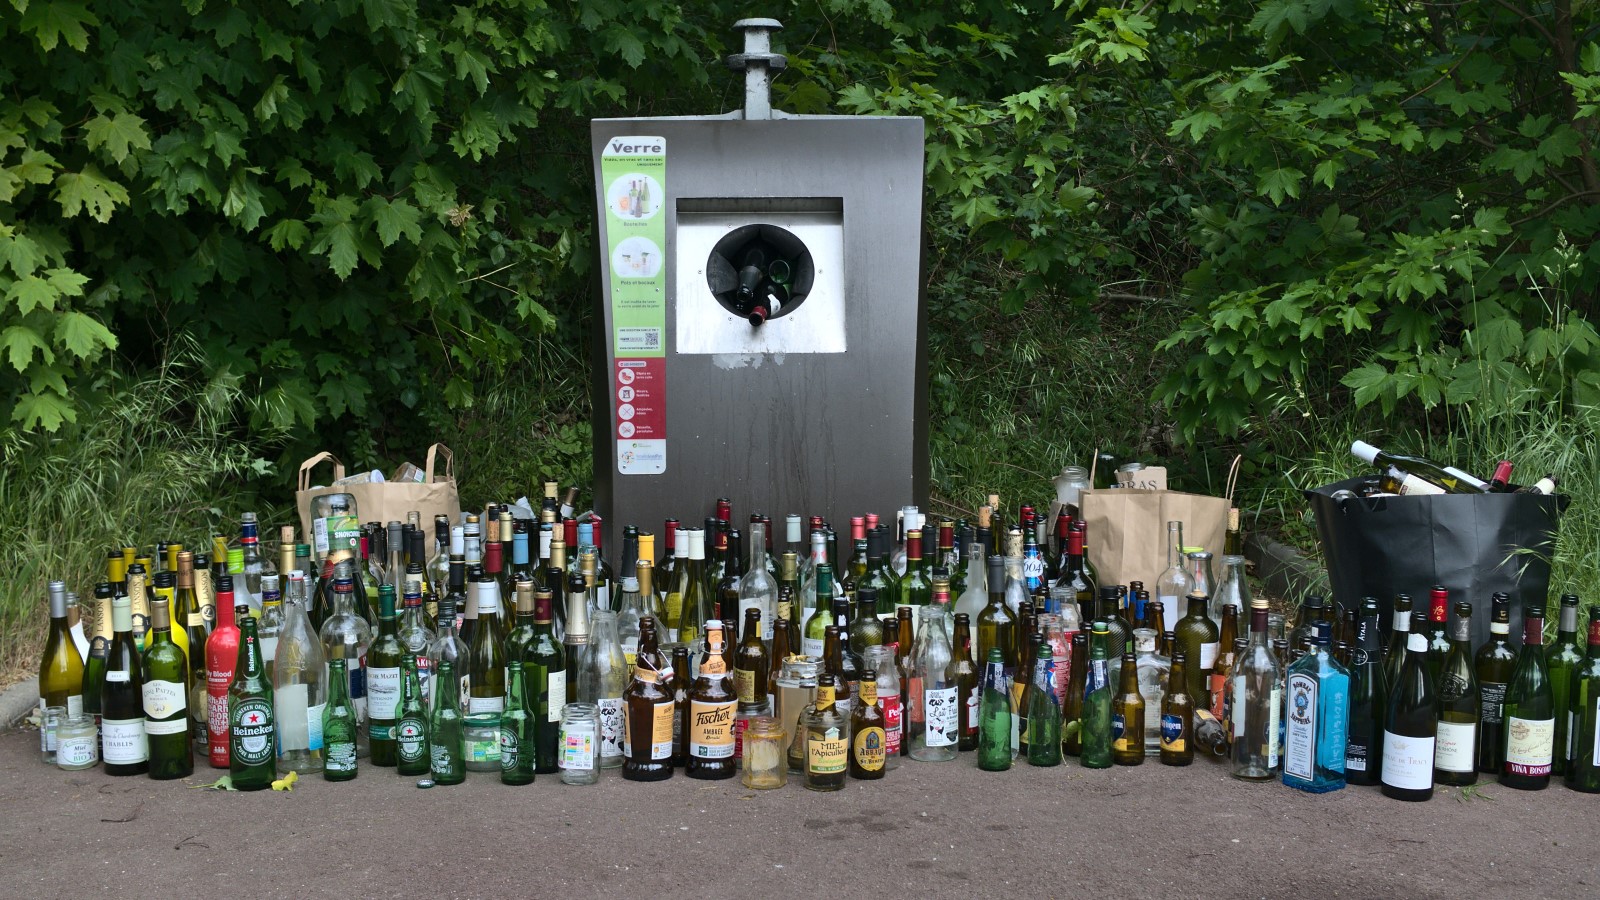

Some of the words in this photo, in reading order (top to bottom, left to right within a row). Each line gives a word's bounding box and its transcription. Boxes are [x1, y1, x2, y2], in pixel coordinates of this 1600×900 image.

[612, 143, 661, 153] Verre
[134, 582, 142, 612] LANSON
[1358, 621, 1366, 641] AYALA
[1292, 681, 1311, 695] BOMBAY
[236, 705, 254, 721] HEINEKEN
[254, 704, 271, 719] ORIGINAL
[696, 706, 731, 727] Fischer
[1290, 712, 1311, 725] SAPPHIRE
[233, 725, 273, 736] Heineken
[703, 727, 723, 735] AMBRÉE
[238, 746, 247, 757] PURE
[261, 742, 272, 756] LAGER
[820, 742, 843, 750] MIEL
[811, 748, 847, 758] l'Apiculteur
[1511, 763, 1528, 774] VIÑA
